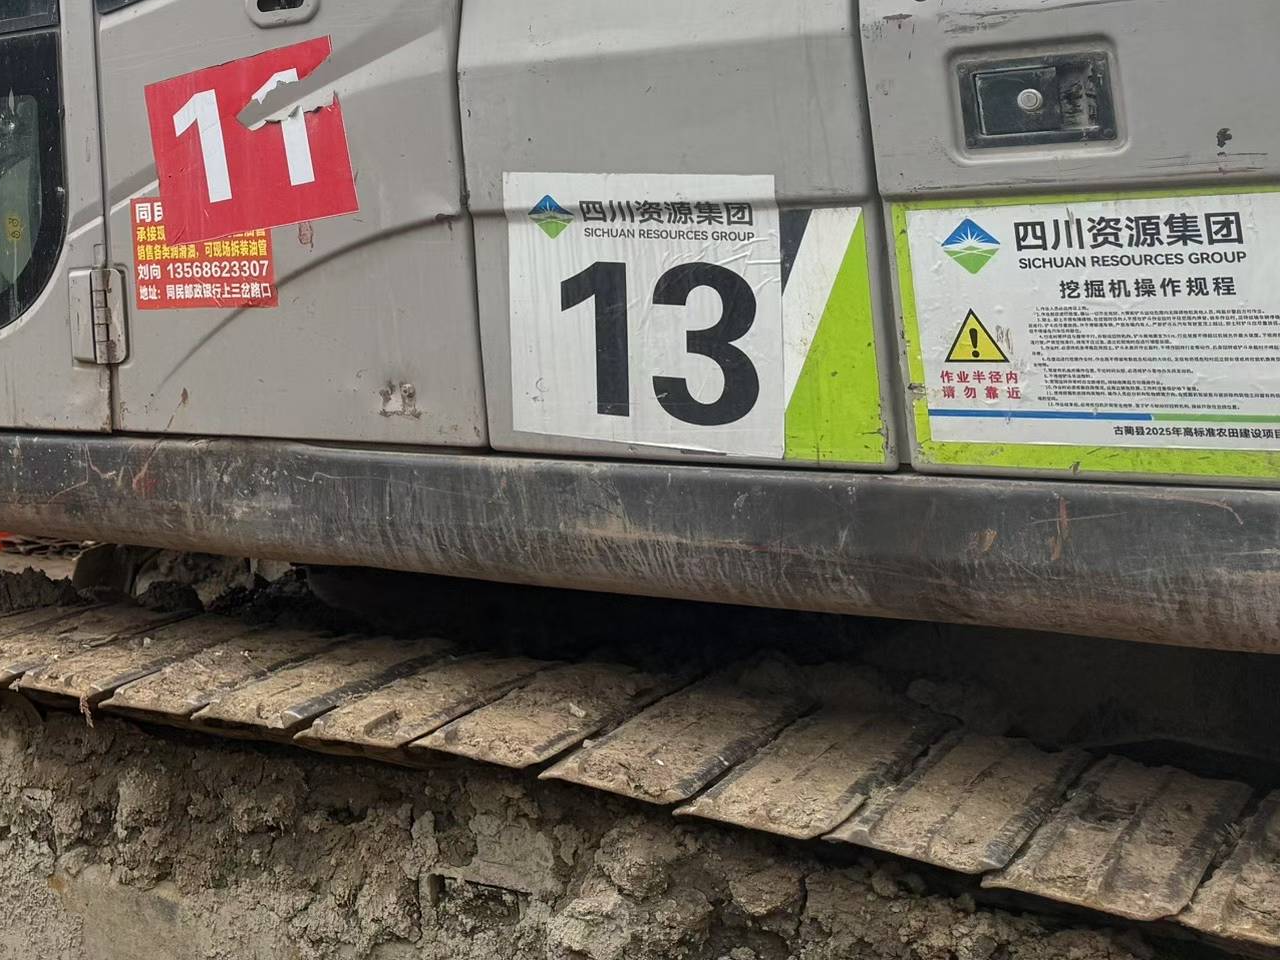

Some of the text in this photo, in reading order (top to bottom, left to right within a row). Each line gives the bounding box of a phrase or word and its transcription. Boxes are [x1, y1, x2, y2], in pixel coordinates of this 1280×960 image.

[579, 200, 754, 227] 四川资源集团
[584, 227, 755, 242] SICHUAN RESOURCES GROUP
[1014, 211, 1245, 252] 四川资源集团
[166, 260, 269, 279] 13568623307
[1019, 251, 1247, 270] SICHUAN RESOURCES GROUP
[1059, 276, 1237, 299] 挖掘机操作规程
[560, 261, 760, 427] 13
[940, 370, 1019, 385] 作业半径内
[942, 385, 1022, 400] 请勿靠近
